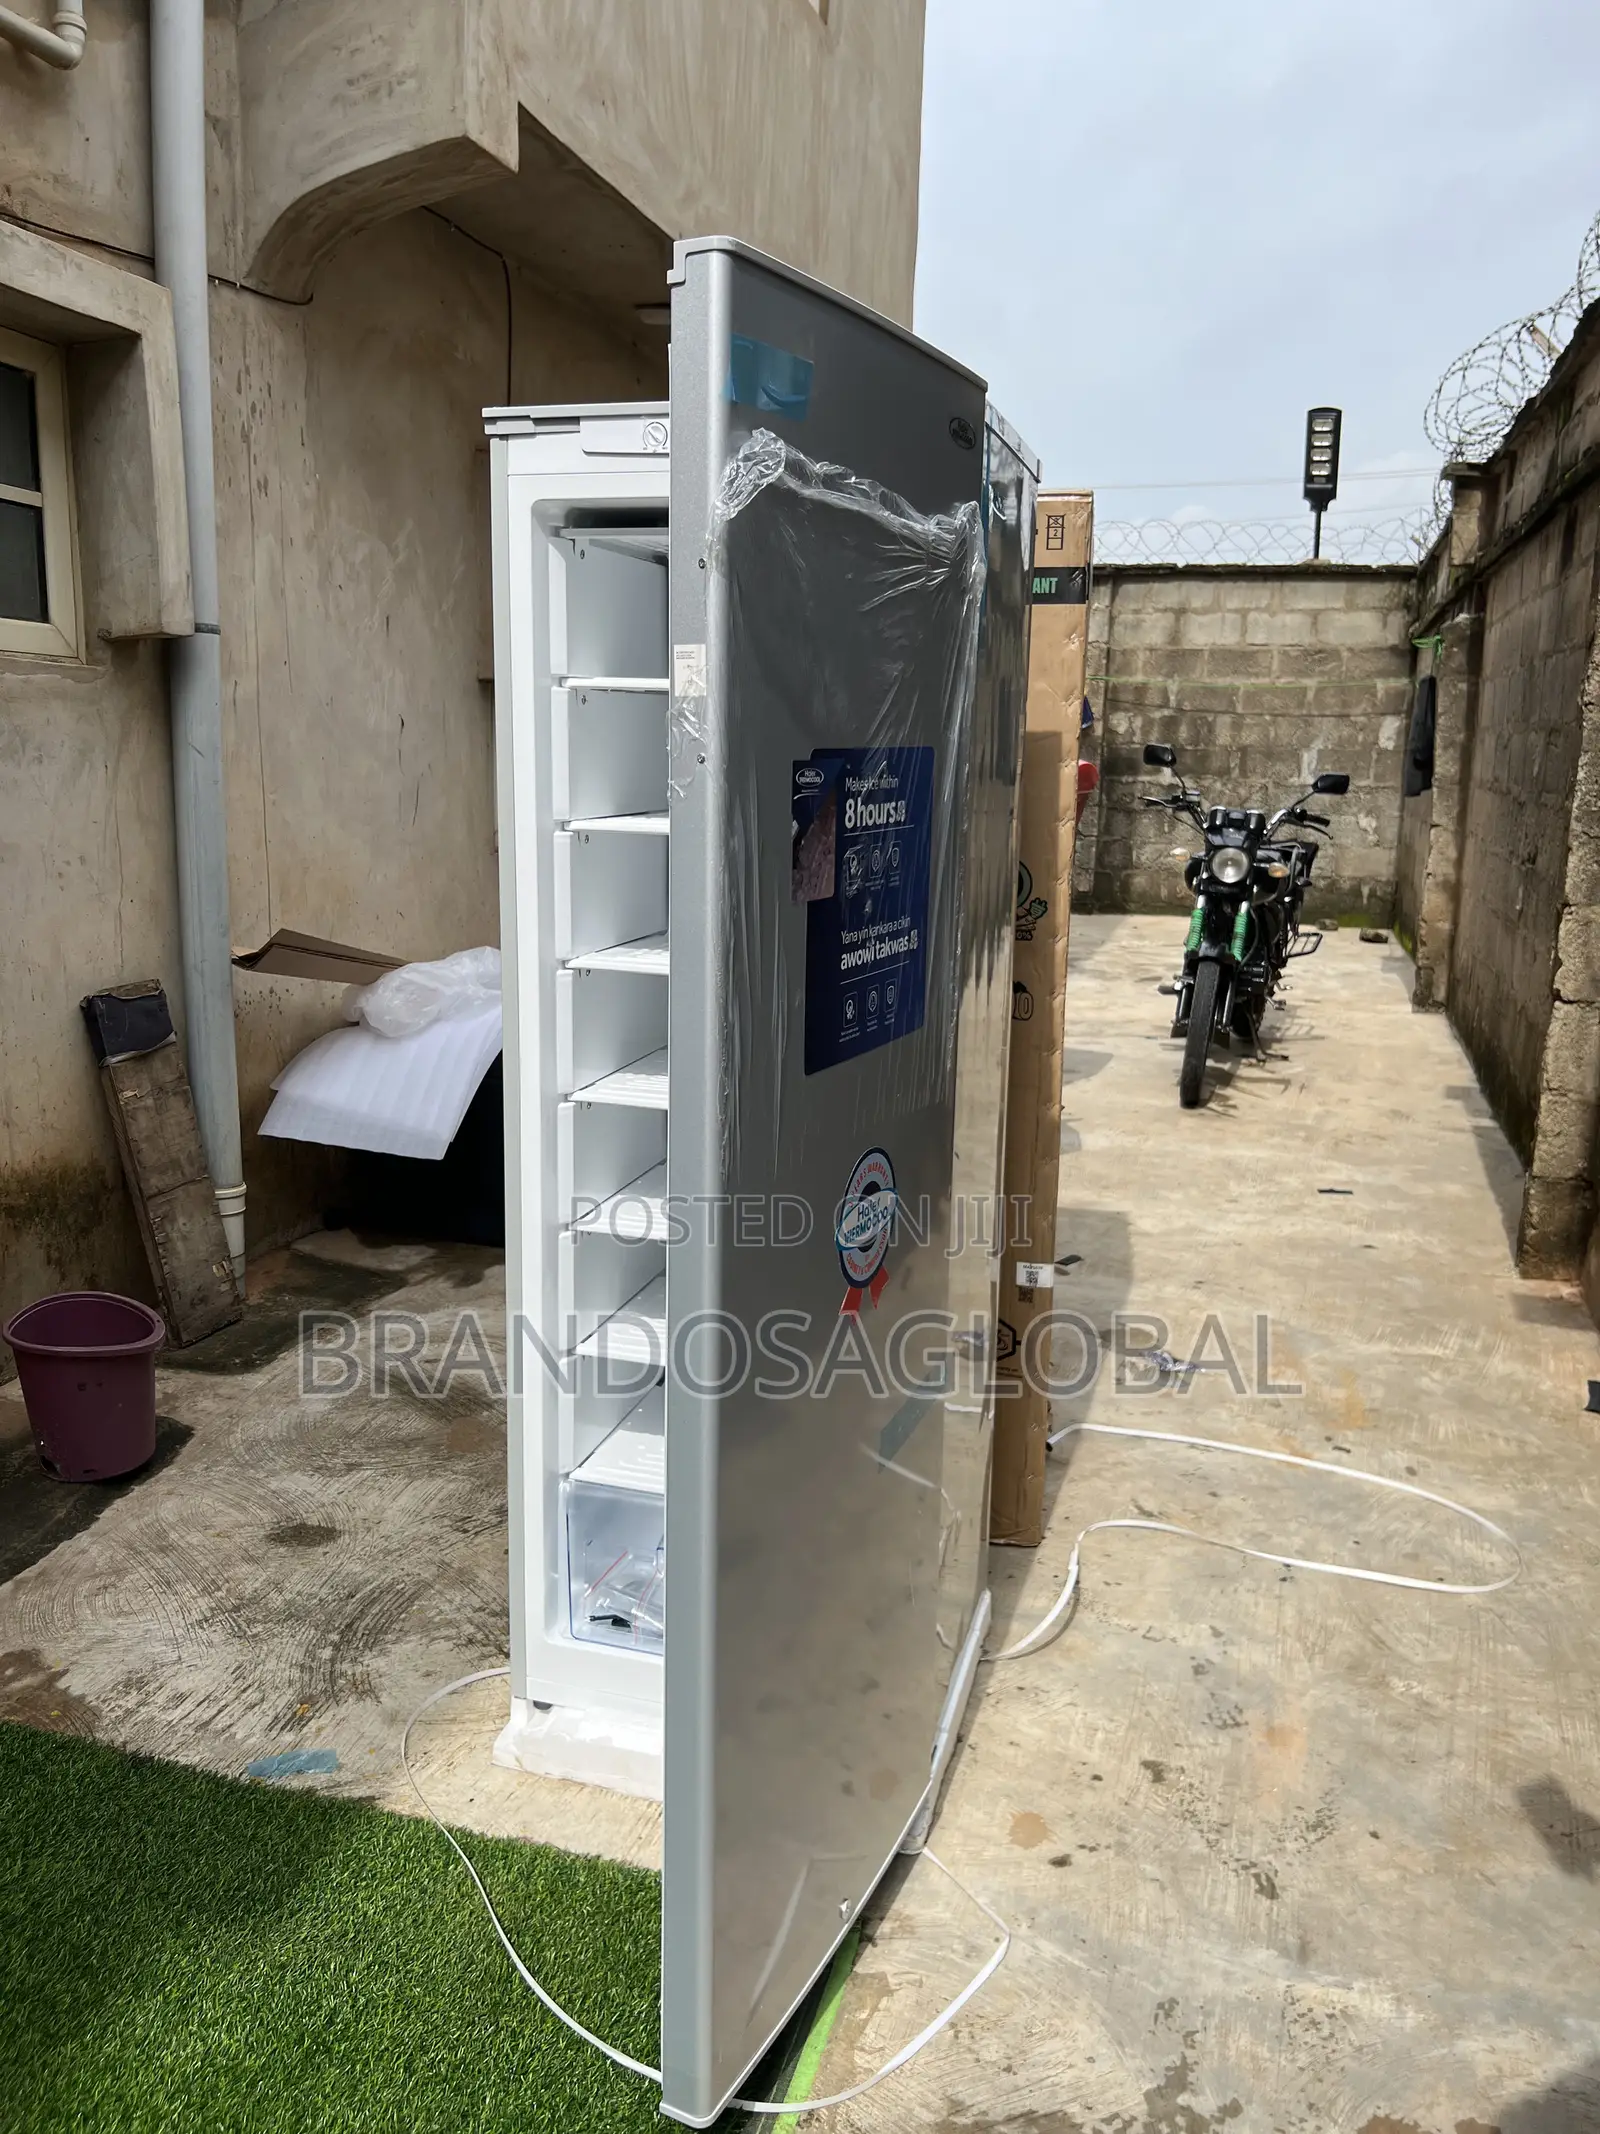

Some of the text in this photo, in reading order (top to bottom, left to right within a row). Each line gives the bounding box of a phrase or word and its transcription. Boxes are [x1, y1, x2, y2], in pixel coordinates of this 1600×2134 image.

[1053, 529, 1059, 537] 2
[845, 776, 868, 792] Makes
[844, 797, 896, 829] 8 hours
[841, 930, 858, 944] Yana
[858, 926, 868, 944] yin
[875, 936, 909, 960] takwas
